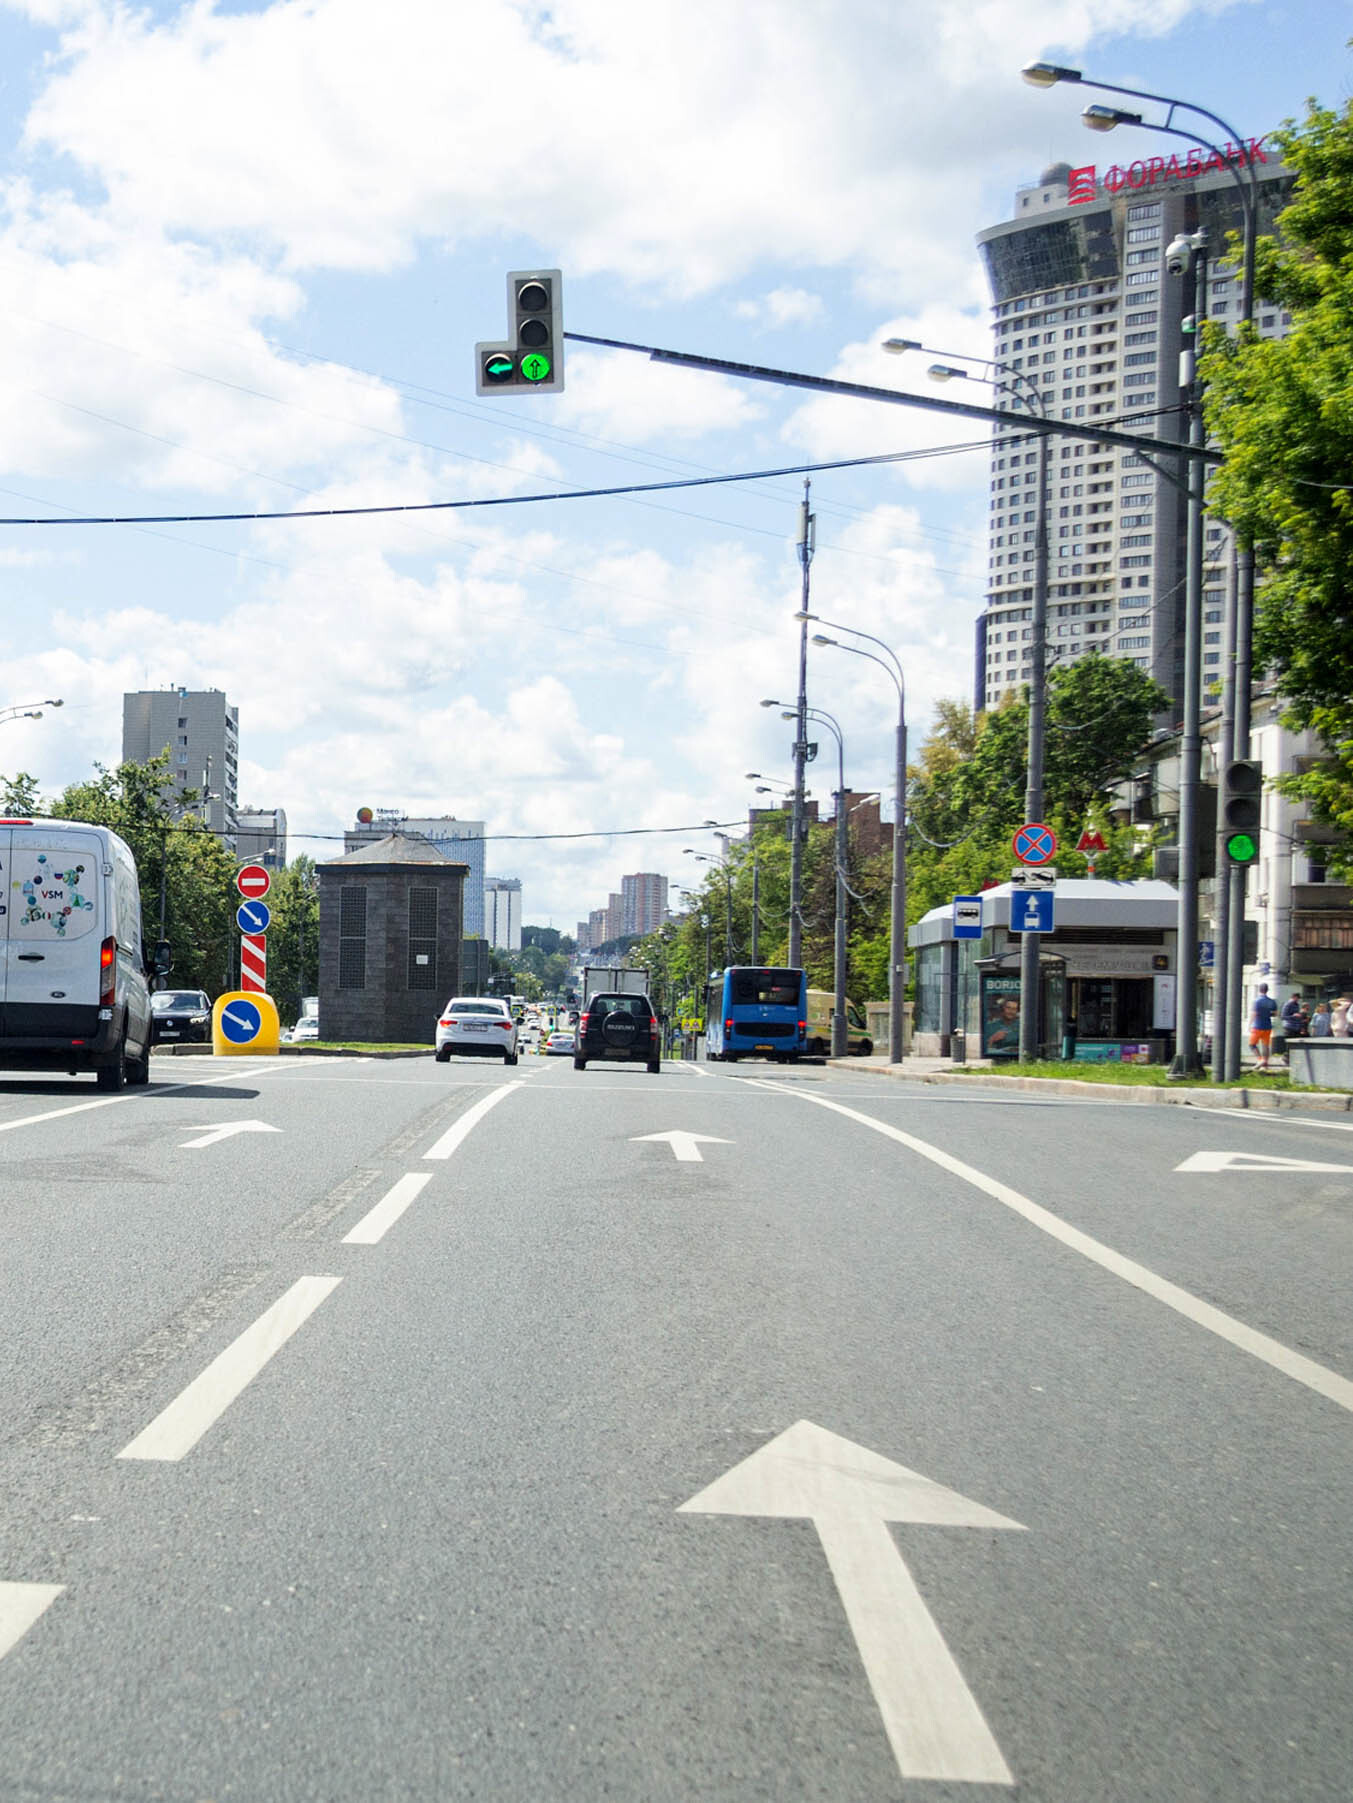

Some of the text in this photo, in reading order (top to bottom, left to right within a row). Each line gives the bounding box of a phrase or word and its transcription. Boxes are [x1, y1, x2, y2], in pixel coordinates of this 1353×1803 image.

[1104, 134, 1270, 193] ФОРАБАНК
[42, 891, 63, 899] VSM
[986, 980, 1022, 990] BORJO
